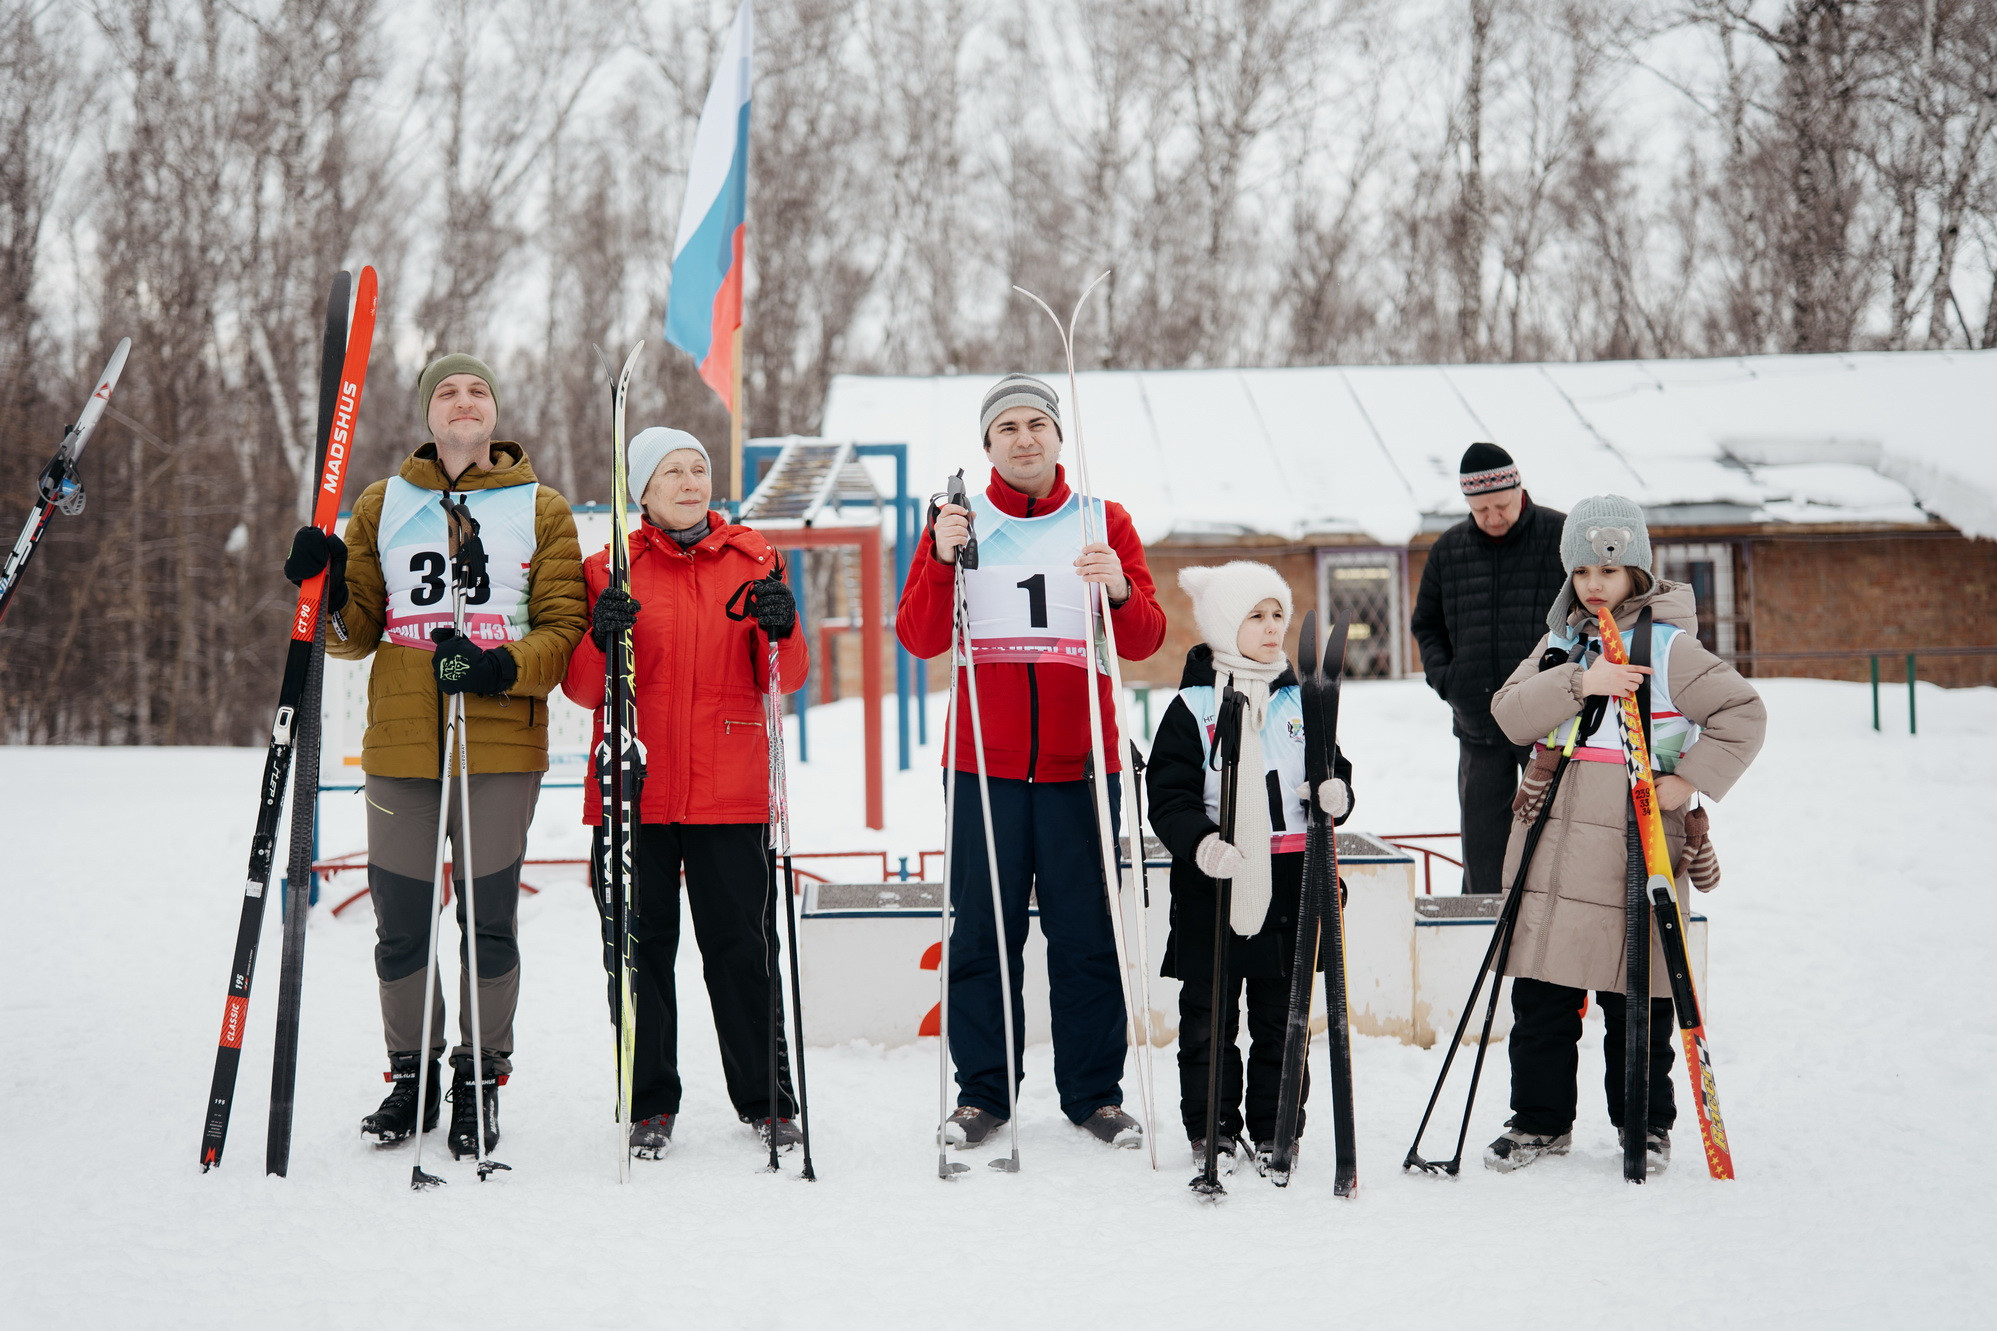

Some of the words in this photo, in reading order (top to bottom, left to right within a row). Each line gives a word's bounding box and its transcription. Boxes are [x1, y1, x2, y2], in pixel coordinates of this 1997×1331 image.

[323, 380, 358, 495] MADSHUS
[1016, 573, 1049, 629] 1
[300, 604, 311, 619] 90
[297, 618, 308, 634] CT
[622, 579, 637, 698] ACTIE
[1203, 714, 1216, 724] НГ
[1621, 696, 1649, 781] LARSE
[1639, 799, 1650, 808] 33
[234, 973, 245, 990] 195
[226, 1002, 240, 1042] CLASSIC
[465, 1078, 496, 1086] MASHUS
[214, 1098, 226, 1106] 195
[1700, 1063, 1729, 1153] Racer
